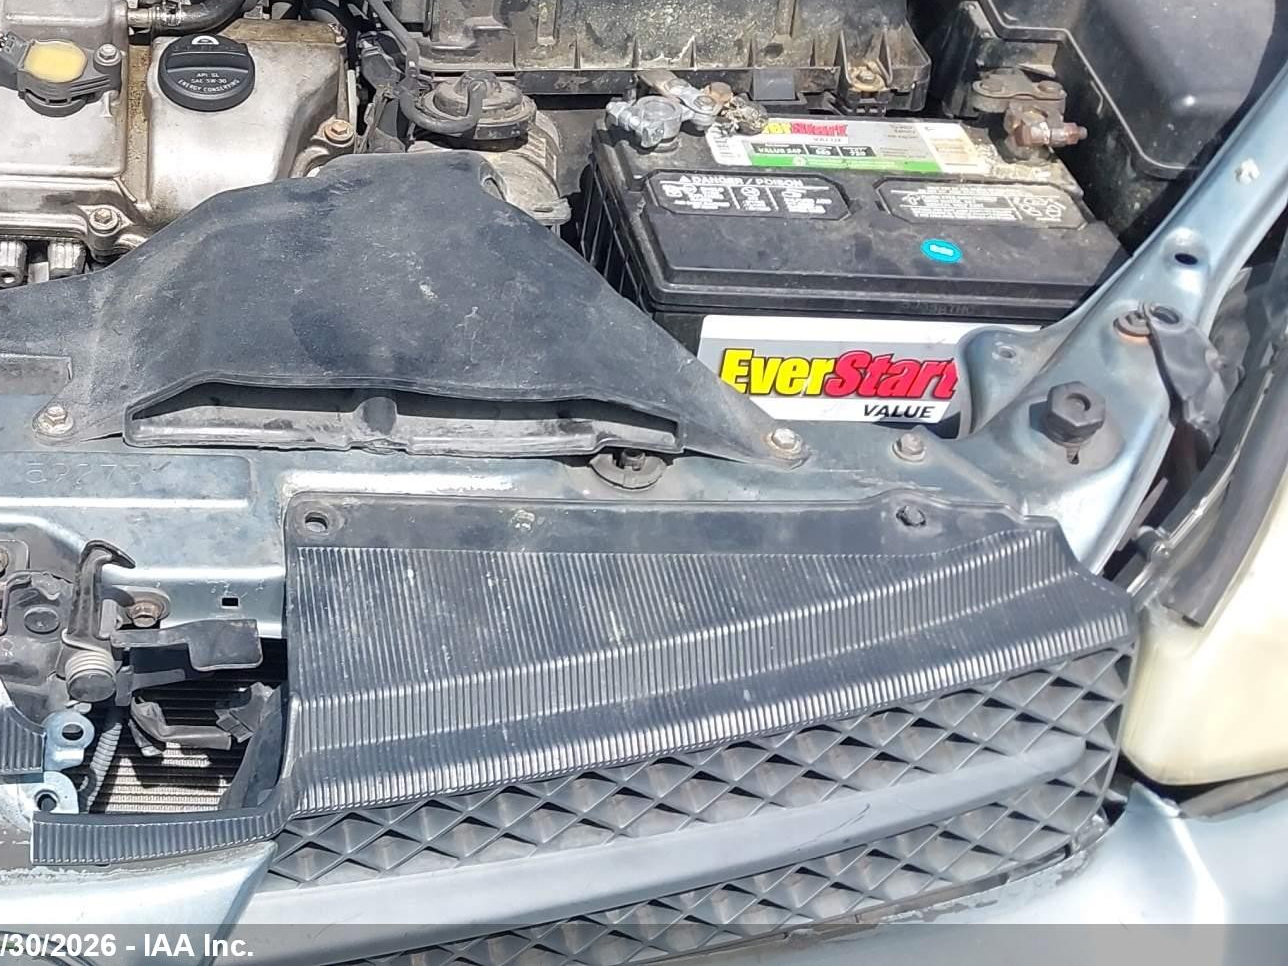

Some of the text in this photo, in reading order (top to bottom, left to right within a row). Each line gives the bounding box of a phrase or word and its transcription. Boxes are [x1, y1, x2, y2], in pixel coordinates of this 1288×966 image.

[177, 79, 202, 91] ENERGY
[693, 176, 744, 186] DANGER
[755, 178, 804, 187] POISON
[718, 347, 960, 400] EverStart
[863, 404, 936, 419] VALUE
